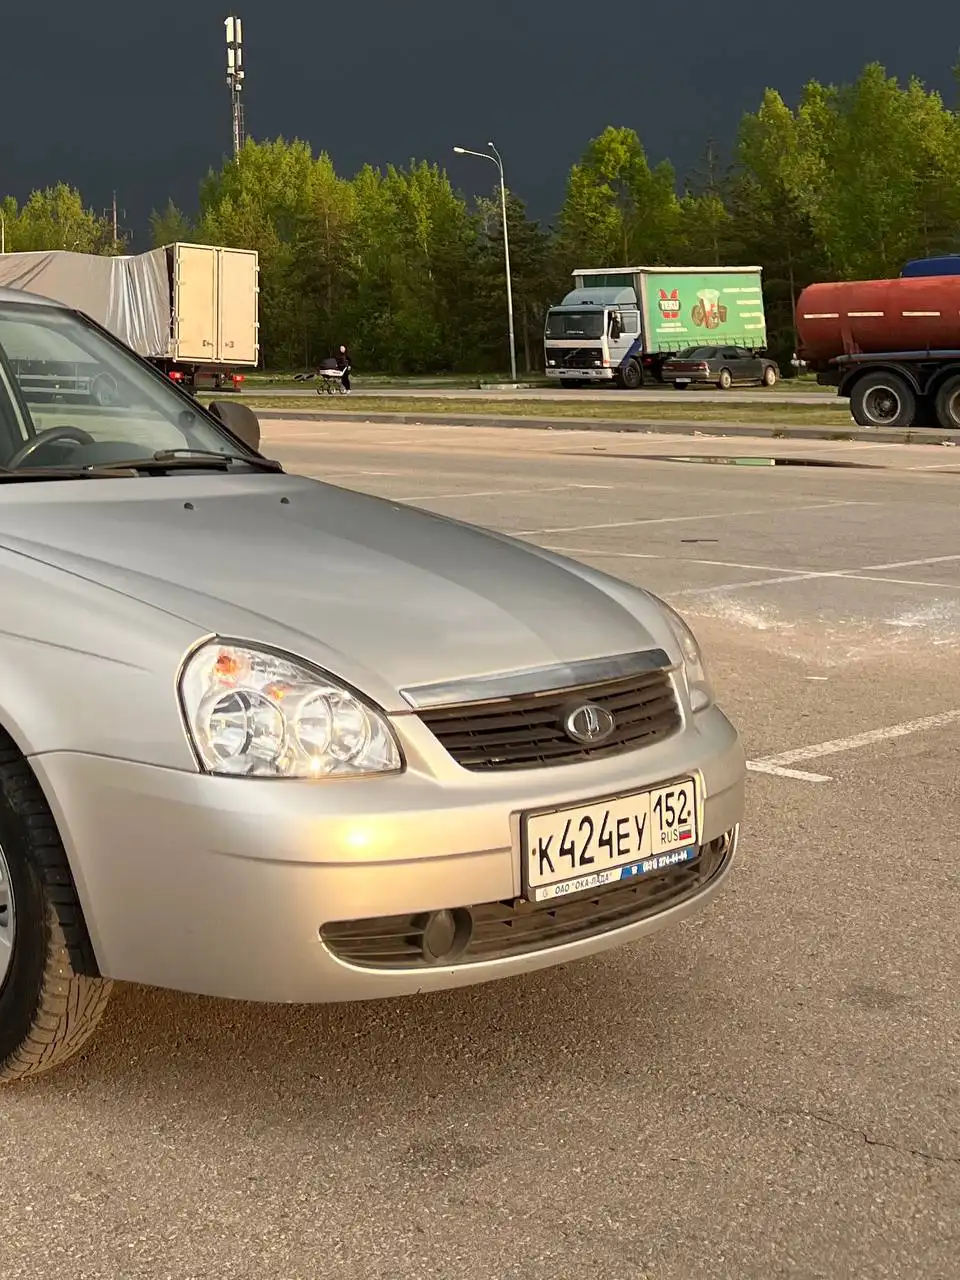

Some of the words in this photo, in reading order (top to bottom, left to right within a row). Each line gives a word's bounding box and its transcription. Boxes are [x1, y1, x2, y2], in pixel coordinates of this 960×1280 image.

[539, 810, 647, 875] К424ЕУ
[653, 789, 688, 831] 152
[660, 828, 679, 845] RUS
[554, 883, 570, 895] ОАО
